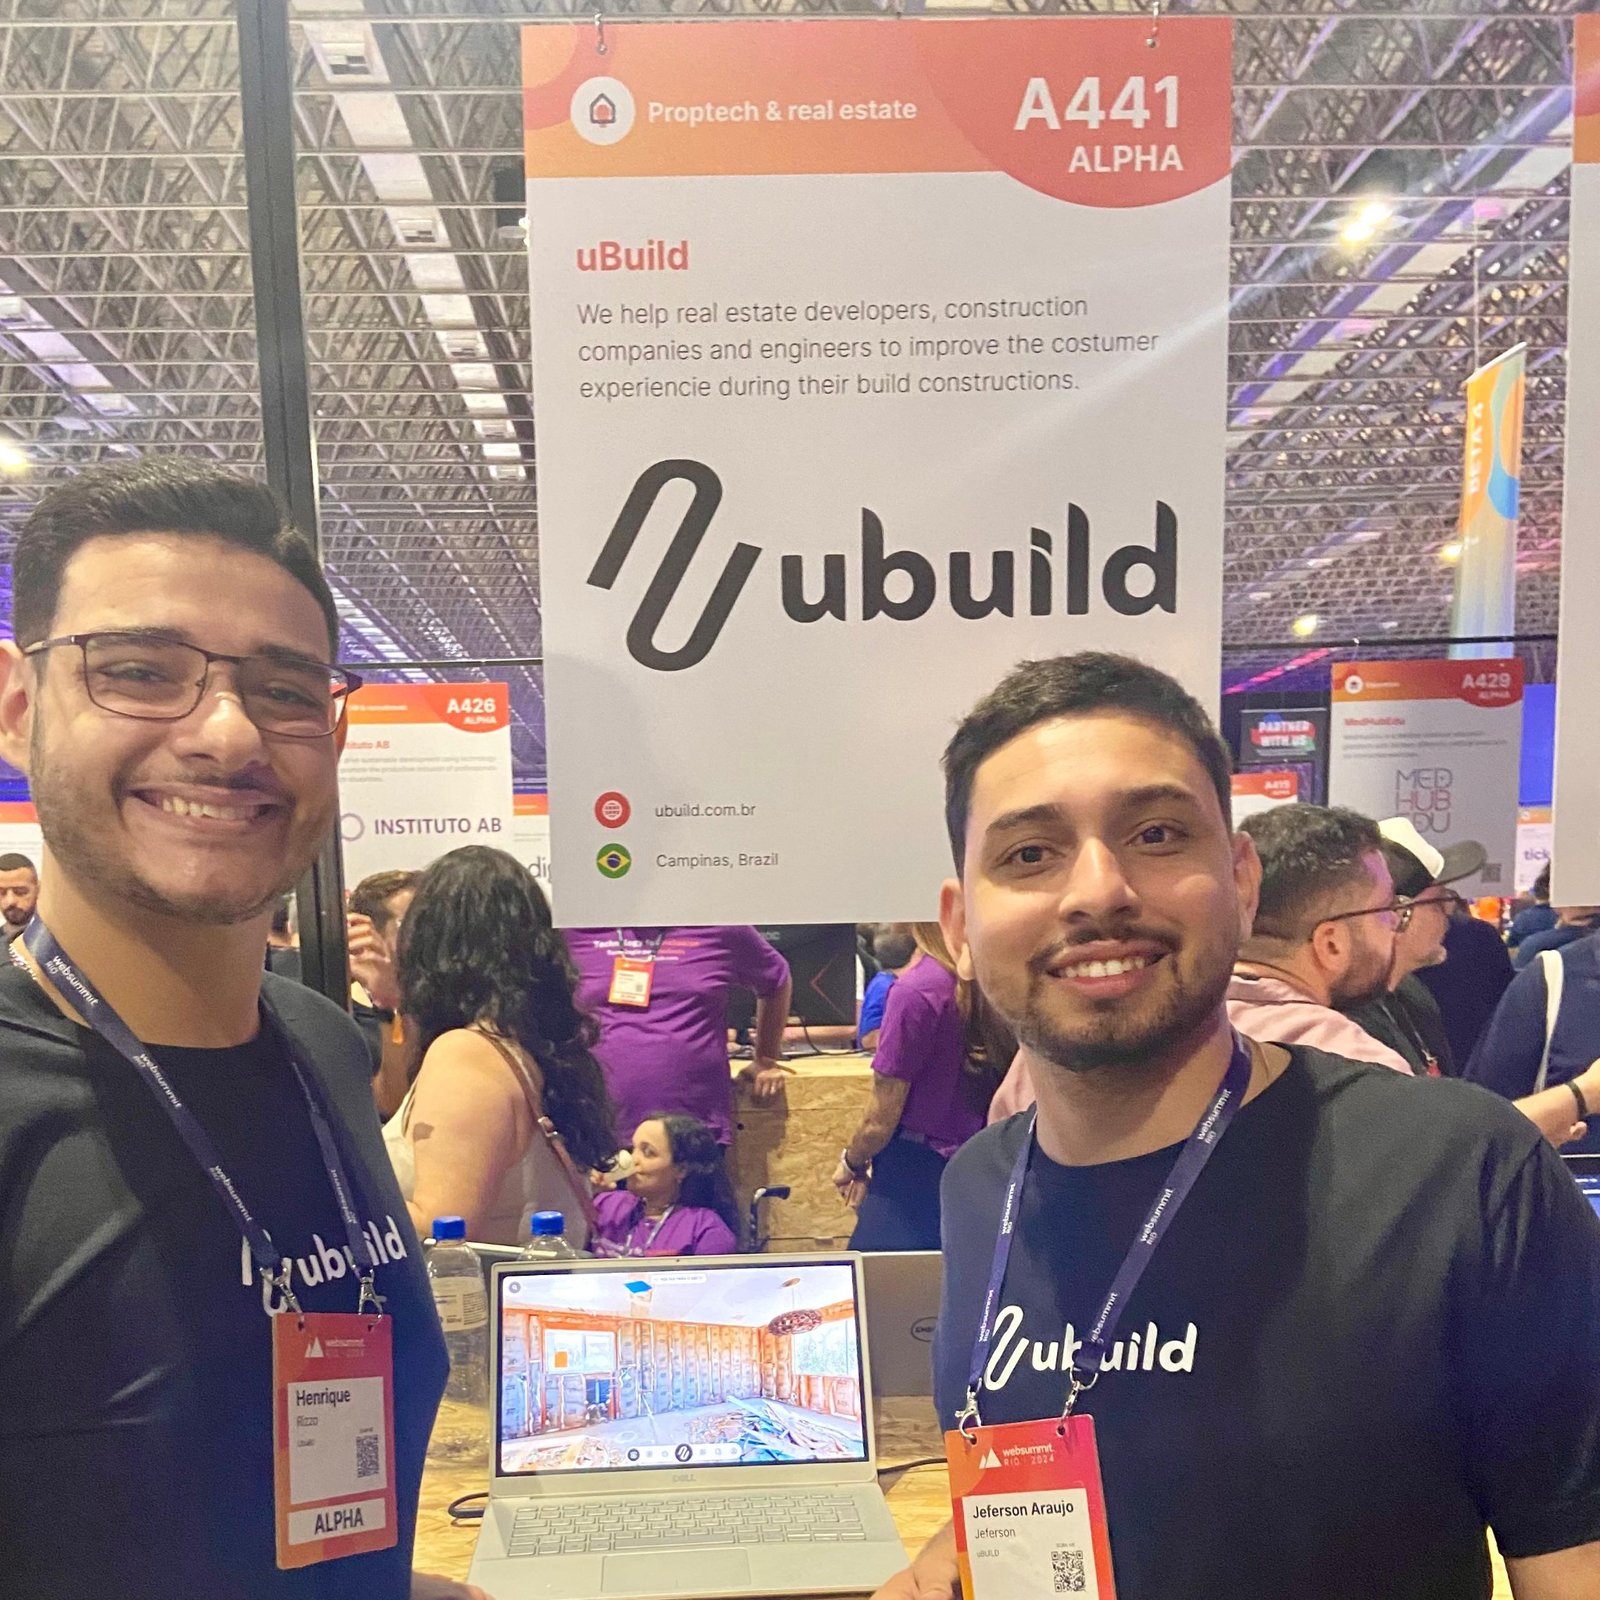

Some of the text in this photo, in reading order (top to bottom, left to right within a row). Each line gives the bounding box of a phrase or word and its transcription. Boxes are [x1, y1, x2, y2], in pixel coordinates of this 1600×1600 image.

[648, 100, 917, 127] Proptech & real estate
[1013, 75, 1179, 130] A441
[1068, 144, 1184, 173] ALPHA
[576, 239, 690, 271] uBuild
[577, 296, 1088, 329] We help real estate developers, construction
[578, 334, 1159, 366] companies and engineers to improve the costumer
[580, 370, 1080, 402] experiencie during their build constructions.
[781, 499, 1178, 623] ubuild
[1462, 673, 1512, 690] A429
[447, 698, 496, 714] A426
[464, 715, 497, 725] ALPHA
[1396, 767, 1453, 790] MED
[654, 802, 757, 819] ubuild.com.br
[1396, 790, 1452, 812] HUB
[374, 817, 502, 836] INSTITUTO AB
[656, 851, 780, 869] Campinas, Brazil
[52, 955, 99, 1006] websummit
[140, 1053, 183, 1108] websummit
[1197, 1088, 1233, 1141] websummit
[214, 1165, 253, 1222] websummit
[1002, 1183, 1017, 1235] websummit
[1140, 1188, 1175, 1243] websummit
[978, 1289, 994, 1342] websummit
[296, 1387, 351, 1408] Henrique
[1003, 1443, 1054, 1457] websummit
[1004, 1452, 1055, 1467] RIO 2024
[314, 1507, 365, 1536] ALPHA
[973, 1501, 1074, 1519] Jeferson Araujo
[975, 1528, 1017, 1539] Jeferson
[977, 1549, 1000, 1558] uBUILD
